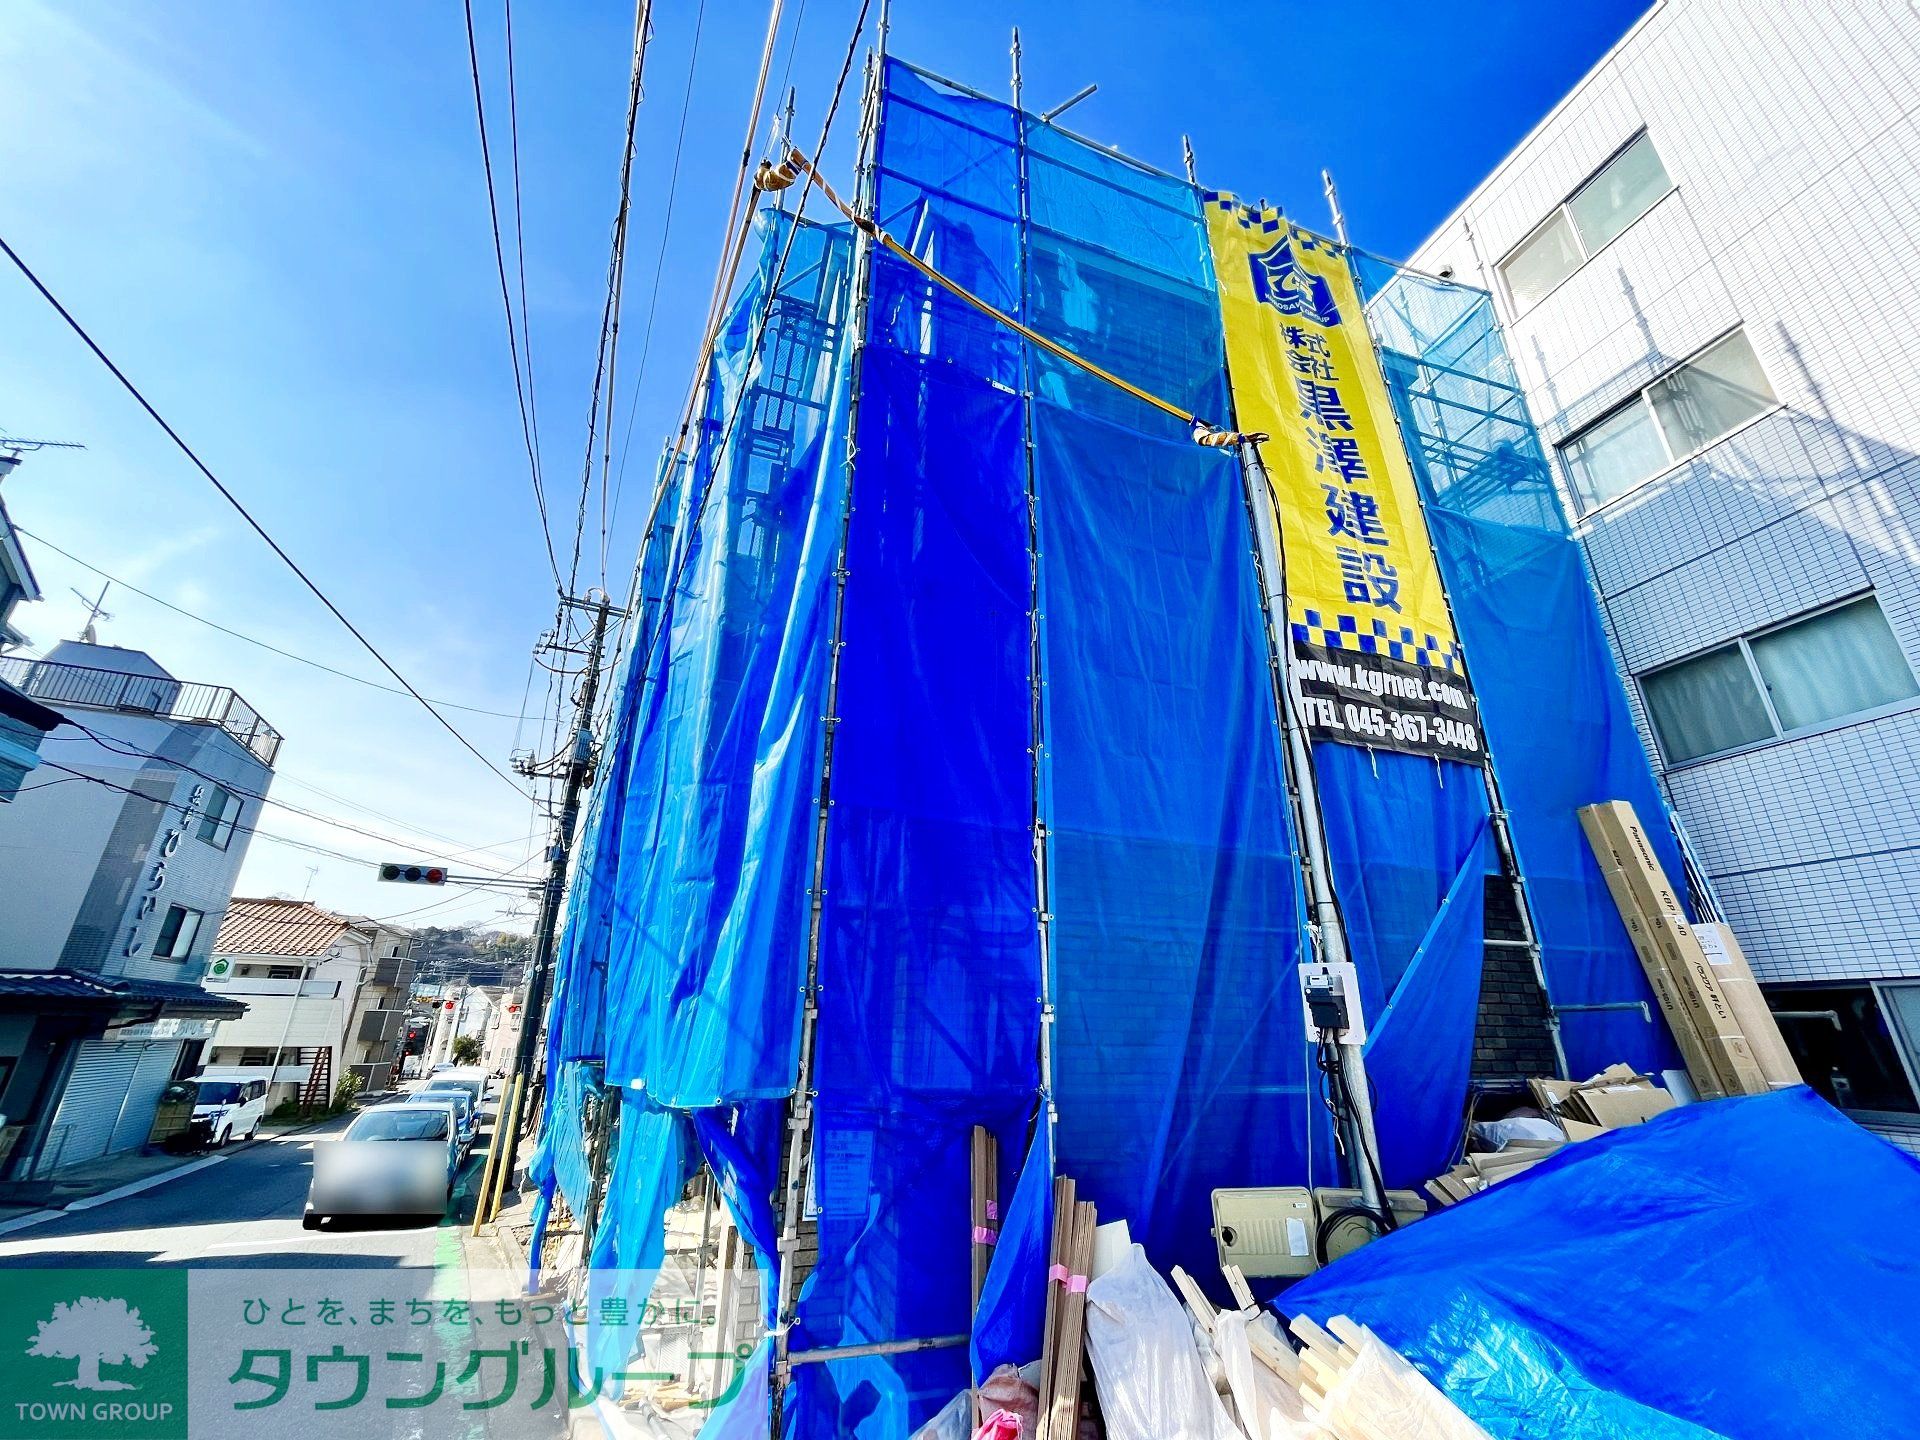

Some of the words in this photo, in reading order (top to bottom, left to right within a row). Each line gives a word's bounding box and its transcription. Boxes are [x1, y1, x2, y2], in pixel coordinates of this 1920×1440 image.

[1300, 696, 1345, 729] TEL
[1344, 703, 1479, 752] 045-367-3448
[1629, 825, 1656, 872] Panasonic
